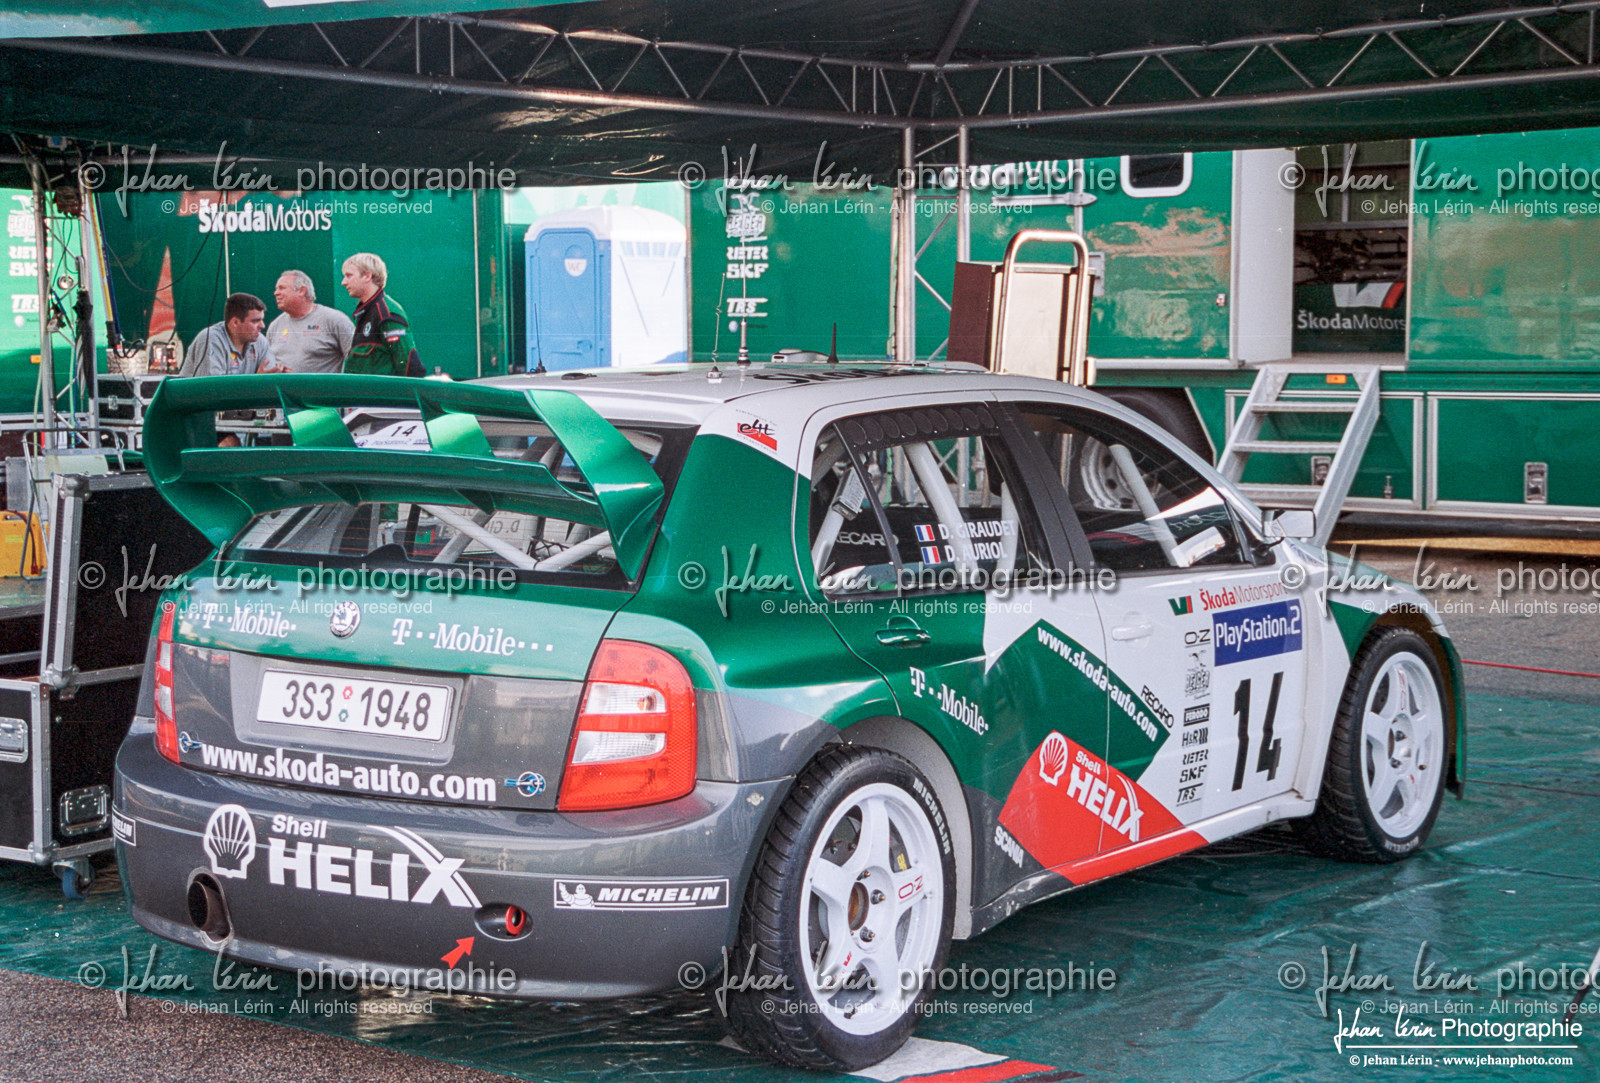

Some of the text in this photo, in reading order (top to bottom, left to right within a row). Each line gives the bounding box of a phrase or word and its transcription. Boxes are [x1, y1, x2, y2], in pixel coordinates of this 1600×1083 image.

[726, 263, 769, 278] SKF
[727, 298, 760, 314] TRS
[391, 425, 417, 437] 14
[938, 519, 1017, 540] D. GIRAUDET
[945, 541, 1007, 562] D. AURIOL
[1037, 627, 1158, 742] www.skoda-auto.com
[282, 680, 431, 732] 3S3 1948
[1141, 685, 1175, 729] RECARO
[1231, 671, 1284, 792] 14
[201, 743, 497, 801] www.skoda-auto.com
[1075, 750, 1101, 775] Shell
[1179, 765, 1207, 783] SKF
[1066, 763, 1144, 843] HELIX
[1177, 785, 1199, 803] TRS
[271, 814, 328, 839] Shell
[913, 777, 951, 855] MICHELIN
[994, 825, 1025, 869] SCANIA
[268, 826, 483, 909] HELIX
[597, 886, 721, 902] MICHELIN
